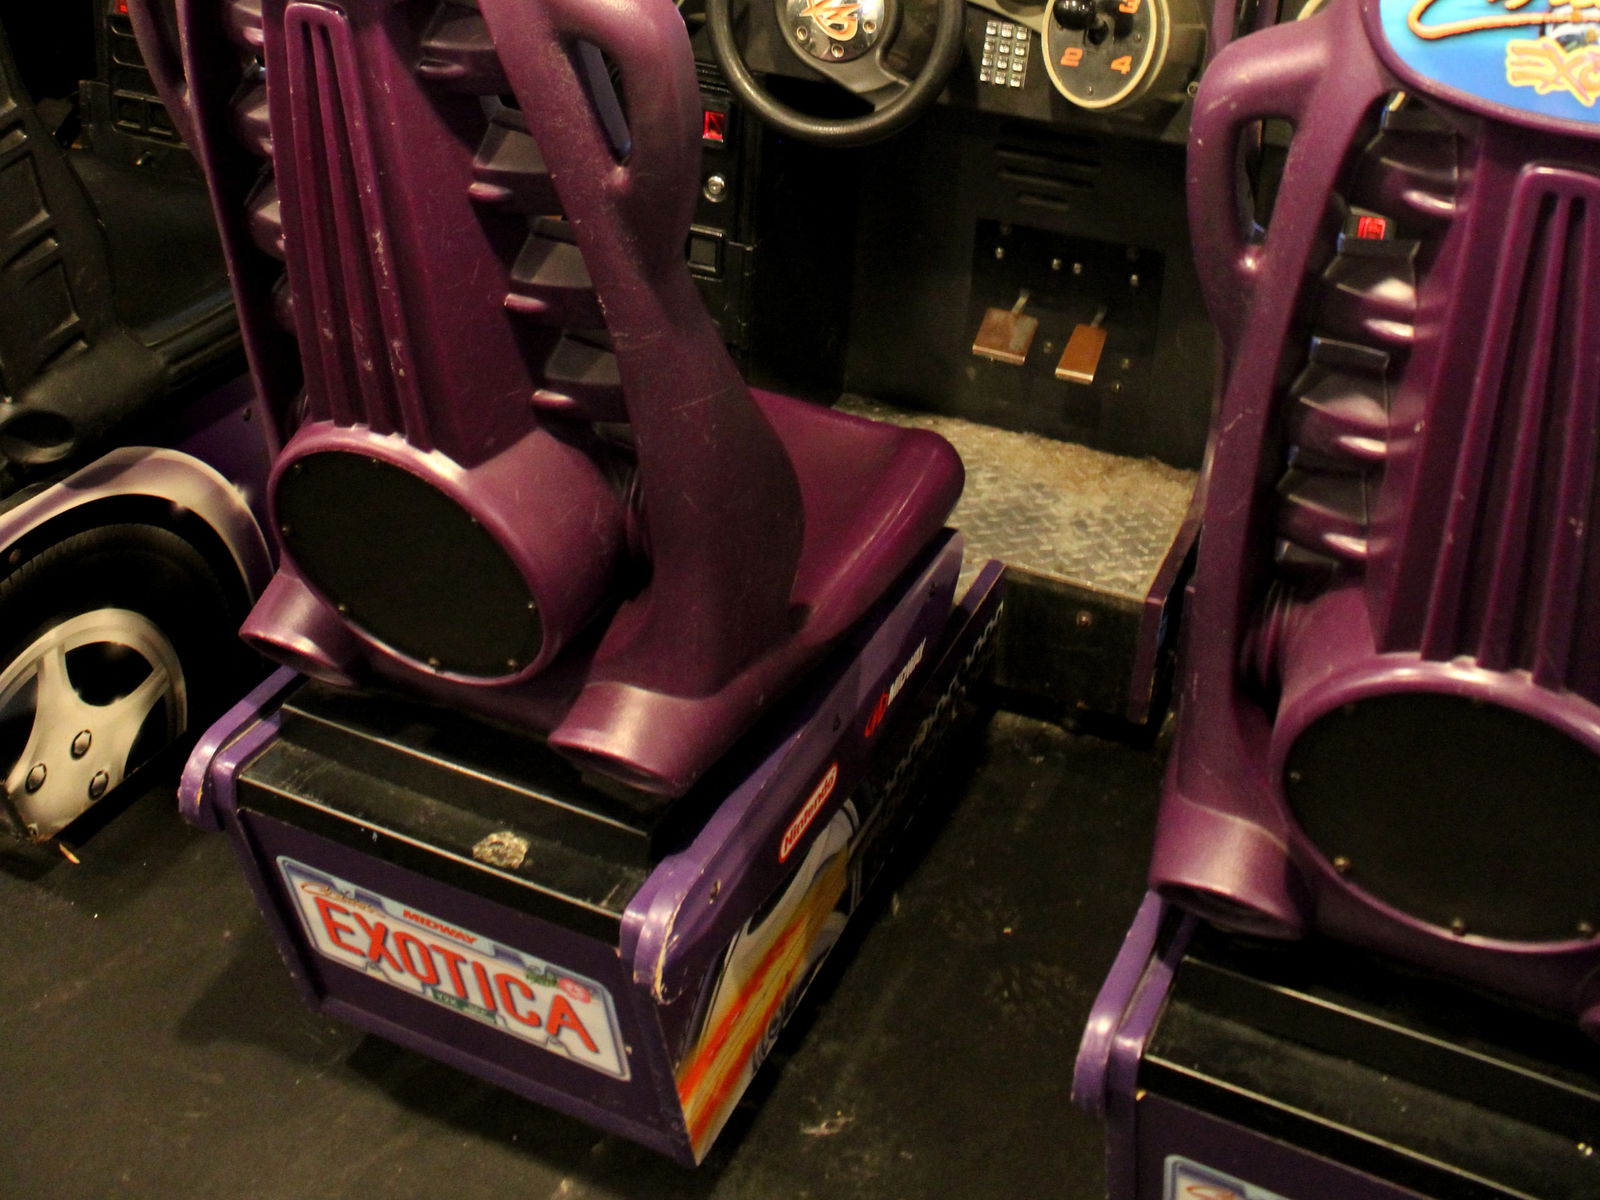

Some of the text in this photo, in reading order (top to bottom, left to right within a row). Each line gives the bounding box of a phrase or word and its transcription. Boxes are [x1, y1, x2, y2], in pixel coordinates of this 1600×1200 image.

[1060, 46, 1083, 67] 2
[1110, 55, 1133, 75] 4
[782, 766, 837, 858] Nintendo
[402, 908, 479, 945] MIDWAY
[313, 895, 600, 1055] EXOTICA
